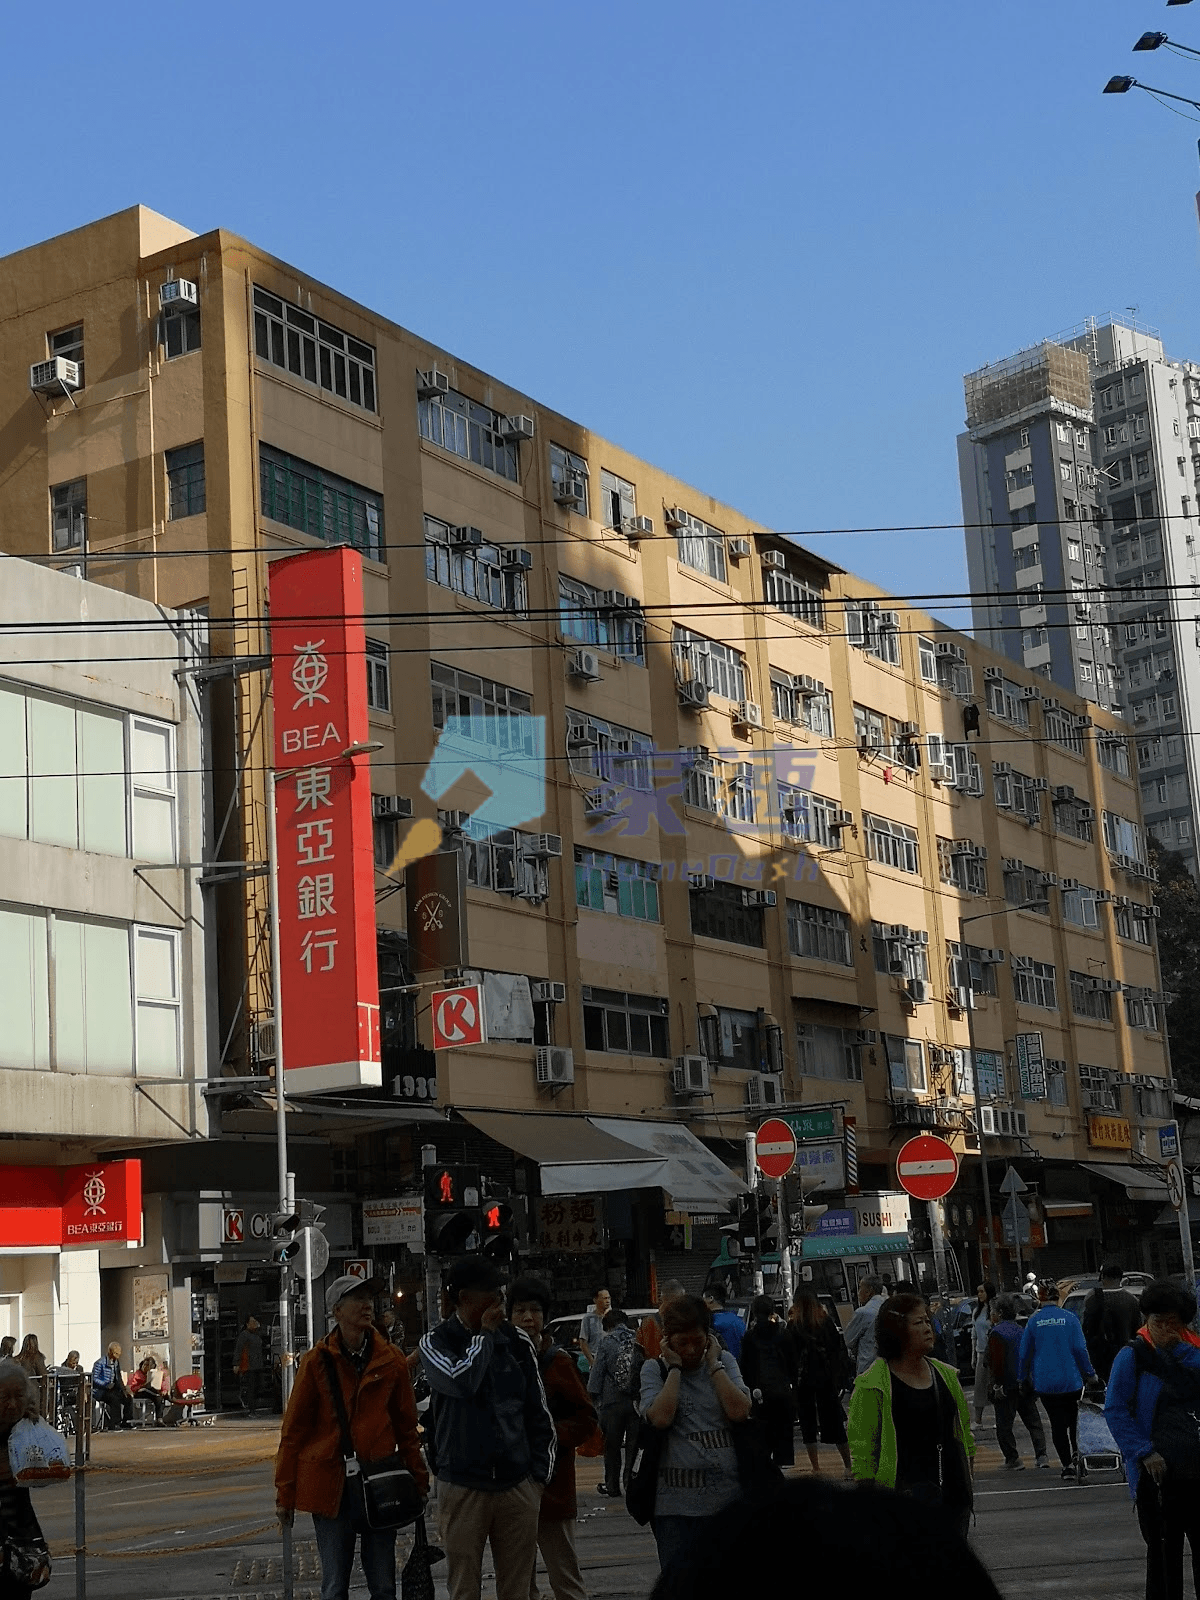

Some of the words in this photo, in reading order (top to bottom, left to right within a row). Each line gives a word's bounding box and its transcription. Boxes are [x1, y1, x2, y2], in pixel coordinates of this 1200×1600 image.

[281, 722, 341, 754] BEA
[294, 766, 340, 974] 東亞銀行
[443, 997, 476, 1037] K
[1020, 1070, 1030, 1093] OUTDOOR
[541, 1199, 596, 1226] 粉麵
[862, 1212, 892, 1228] SUSHI
[1036, 1317, 1066, 1328] stadium
